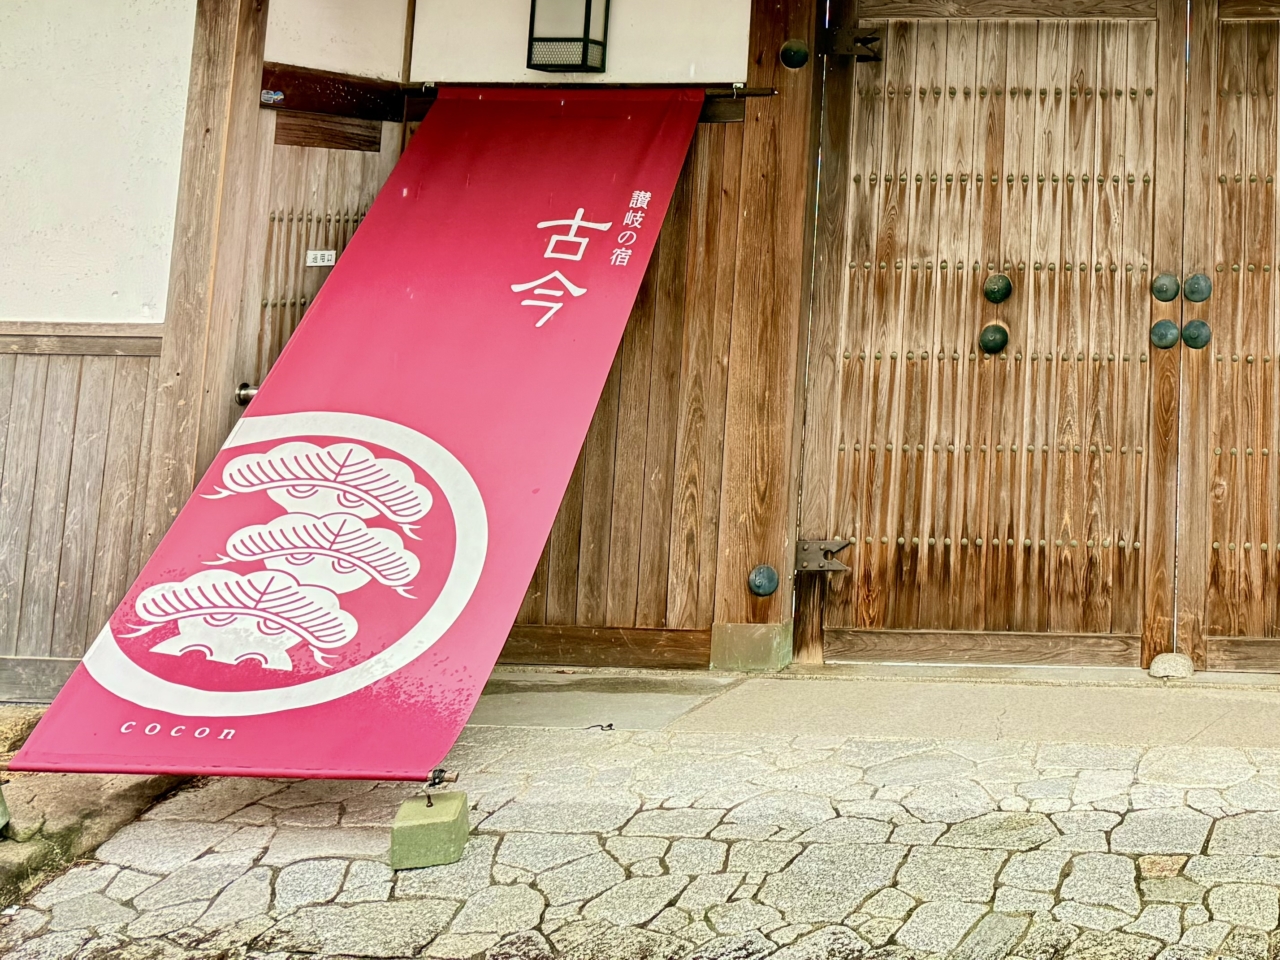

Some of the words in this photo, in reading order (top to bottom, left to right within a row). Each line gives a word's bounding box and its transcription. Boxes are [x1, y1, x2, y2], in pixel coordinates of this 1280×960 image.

[609, 190, 652, 267] 讃岐の宿
[510, 207, 613, 328] 古今
[119, 721, 236, 740] cocon
